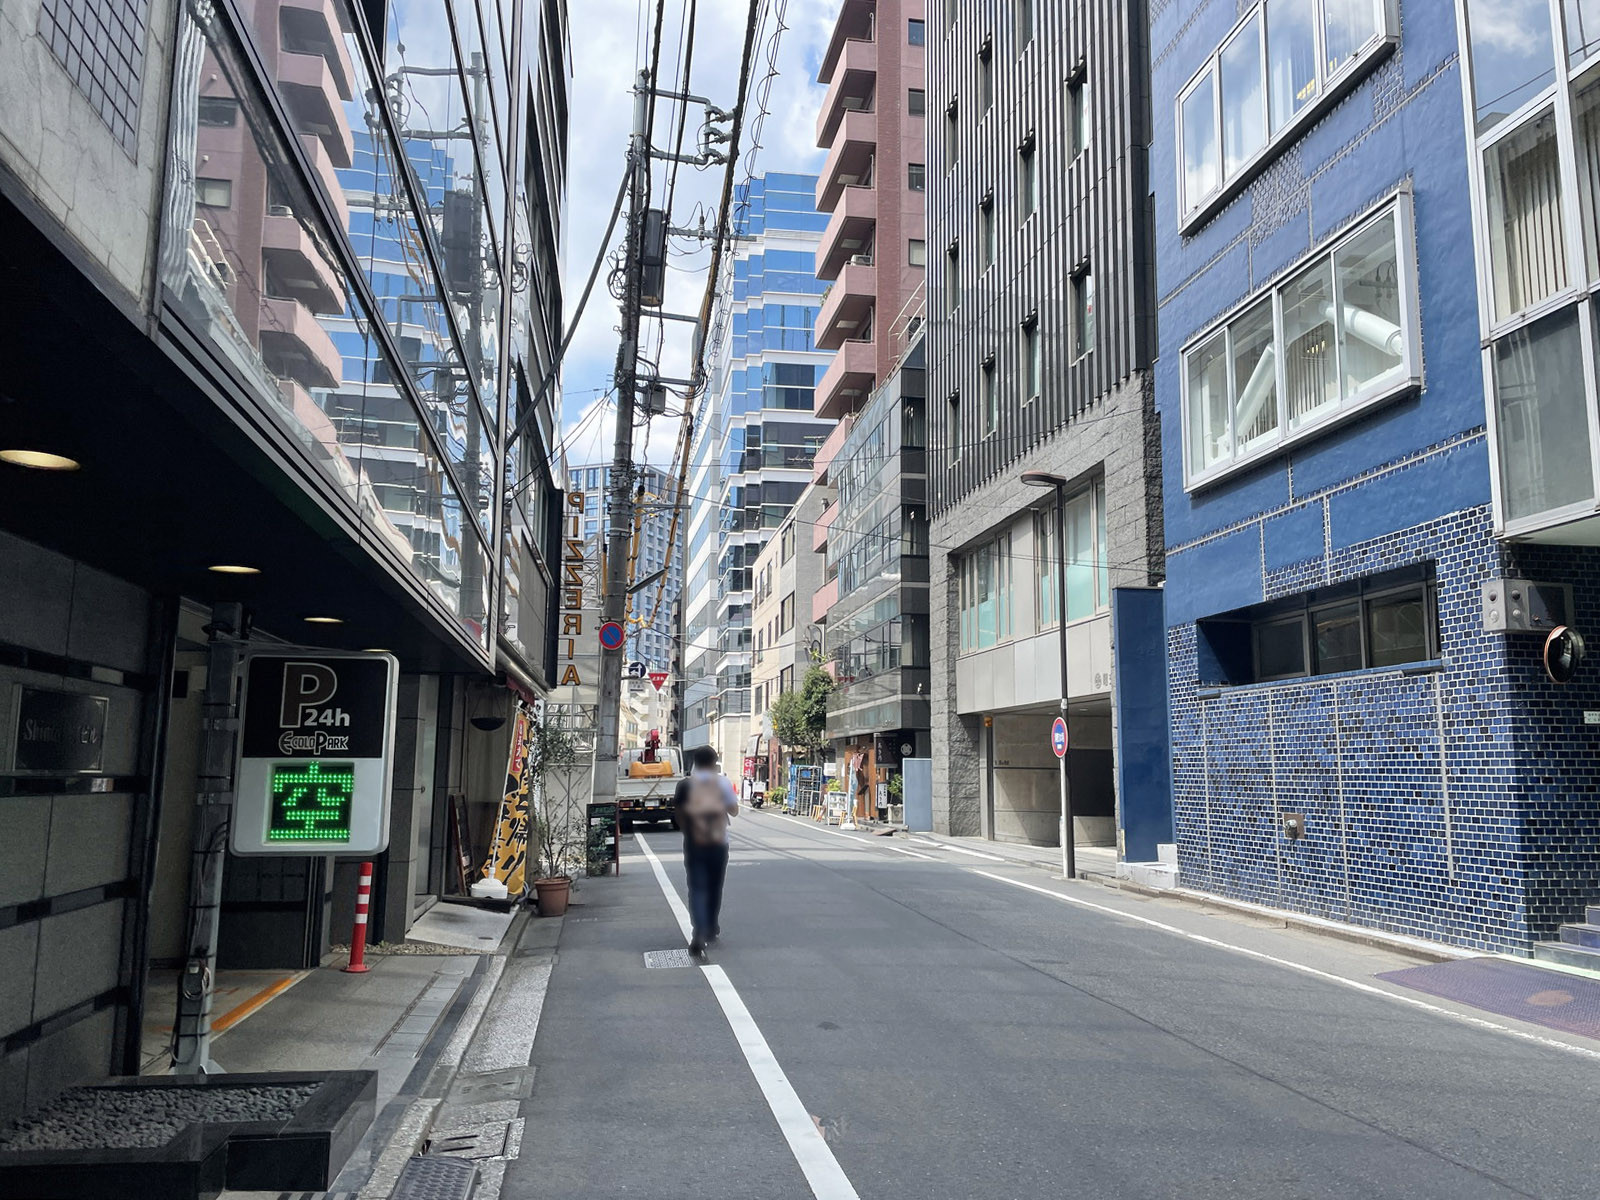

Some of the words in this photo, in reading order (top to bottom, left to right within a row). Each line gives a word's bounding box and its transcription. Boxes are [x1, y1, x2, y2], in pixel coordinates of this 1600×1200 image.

[279, 662, 338, 728] P
[303, 708, 350, 727] 24h
[269, 761, 355, 839] 空
